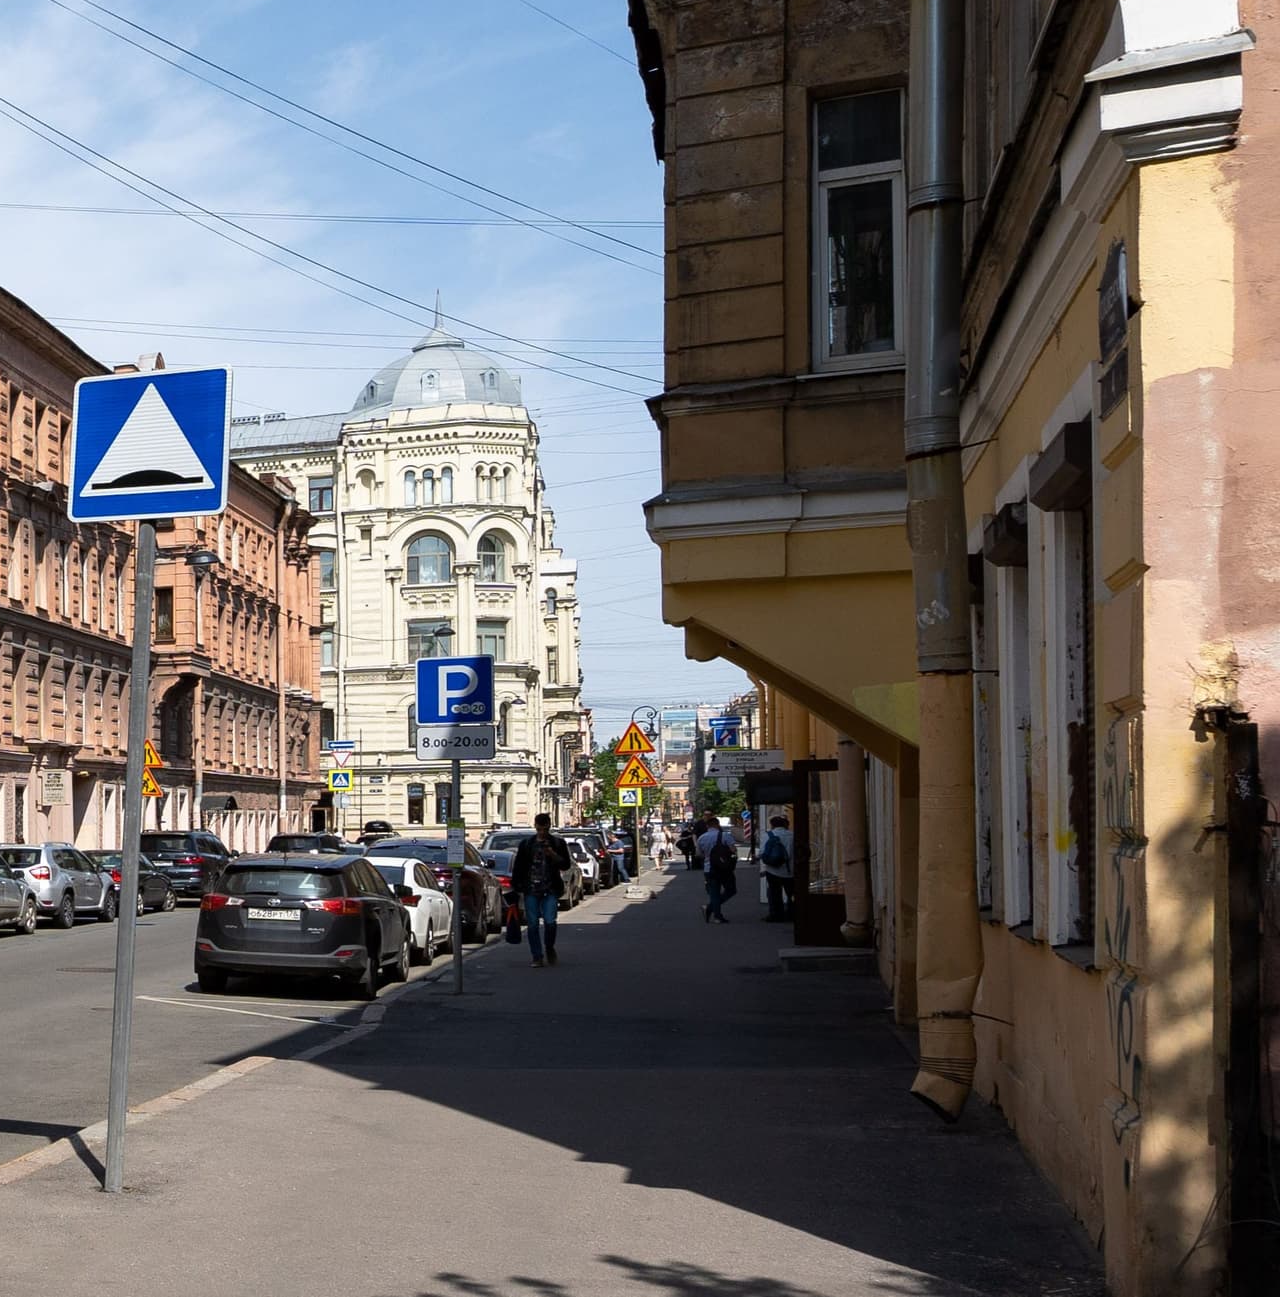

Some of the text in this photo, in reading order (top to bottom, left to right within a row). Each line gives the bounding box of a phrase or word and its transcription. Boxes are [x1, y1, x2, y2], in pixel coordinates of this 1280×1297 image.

[438, 665, 478, 716] P
[473, 704, 485, 713] 20
[422, 737, 488, 748] 8.00-20.00
